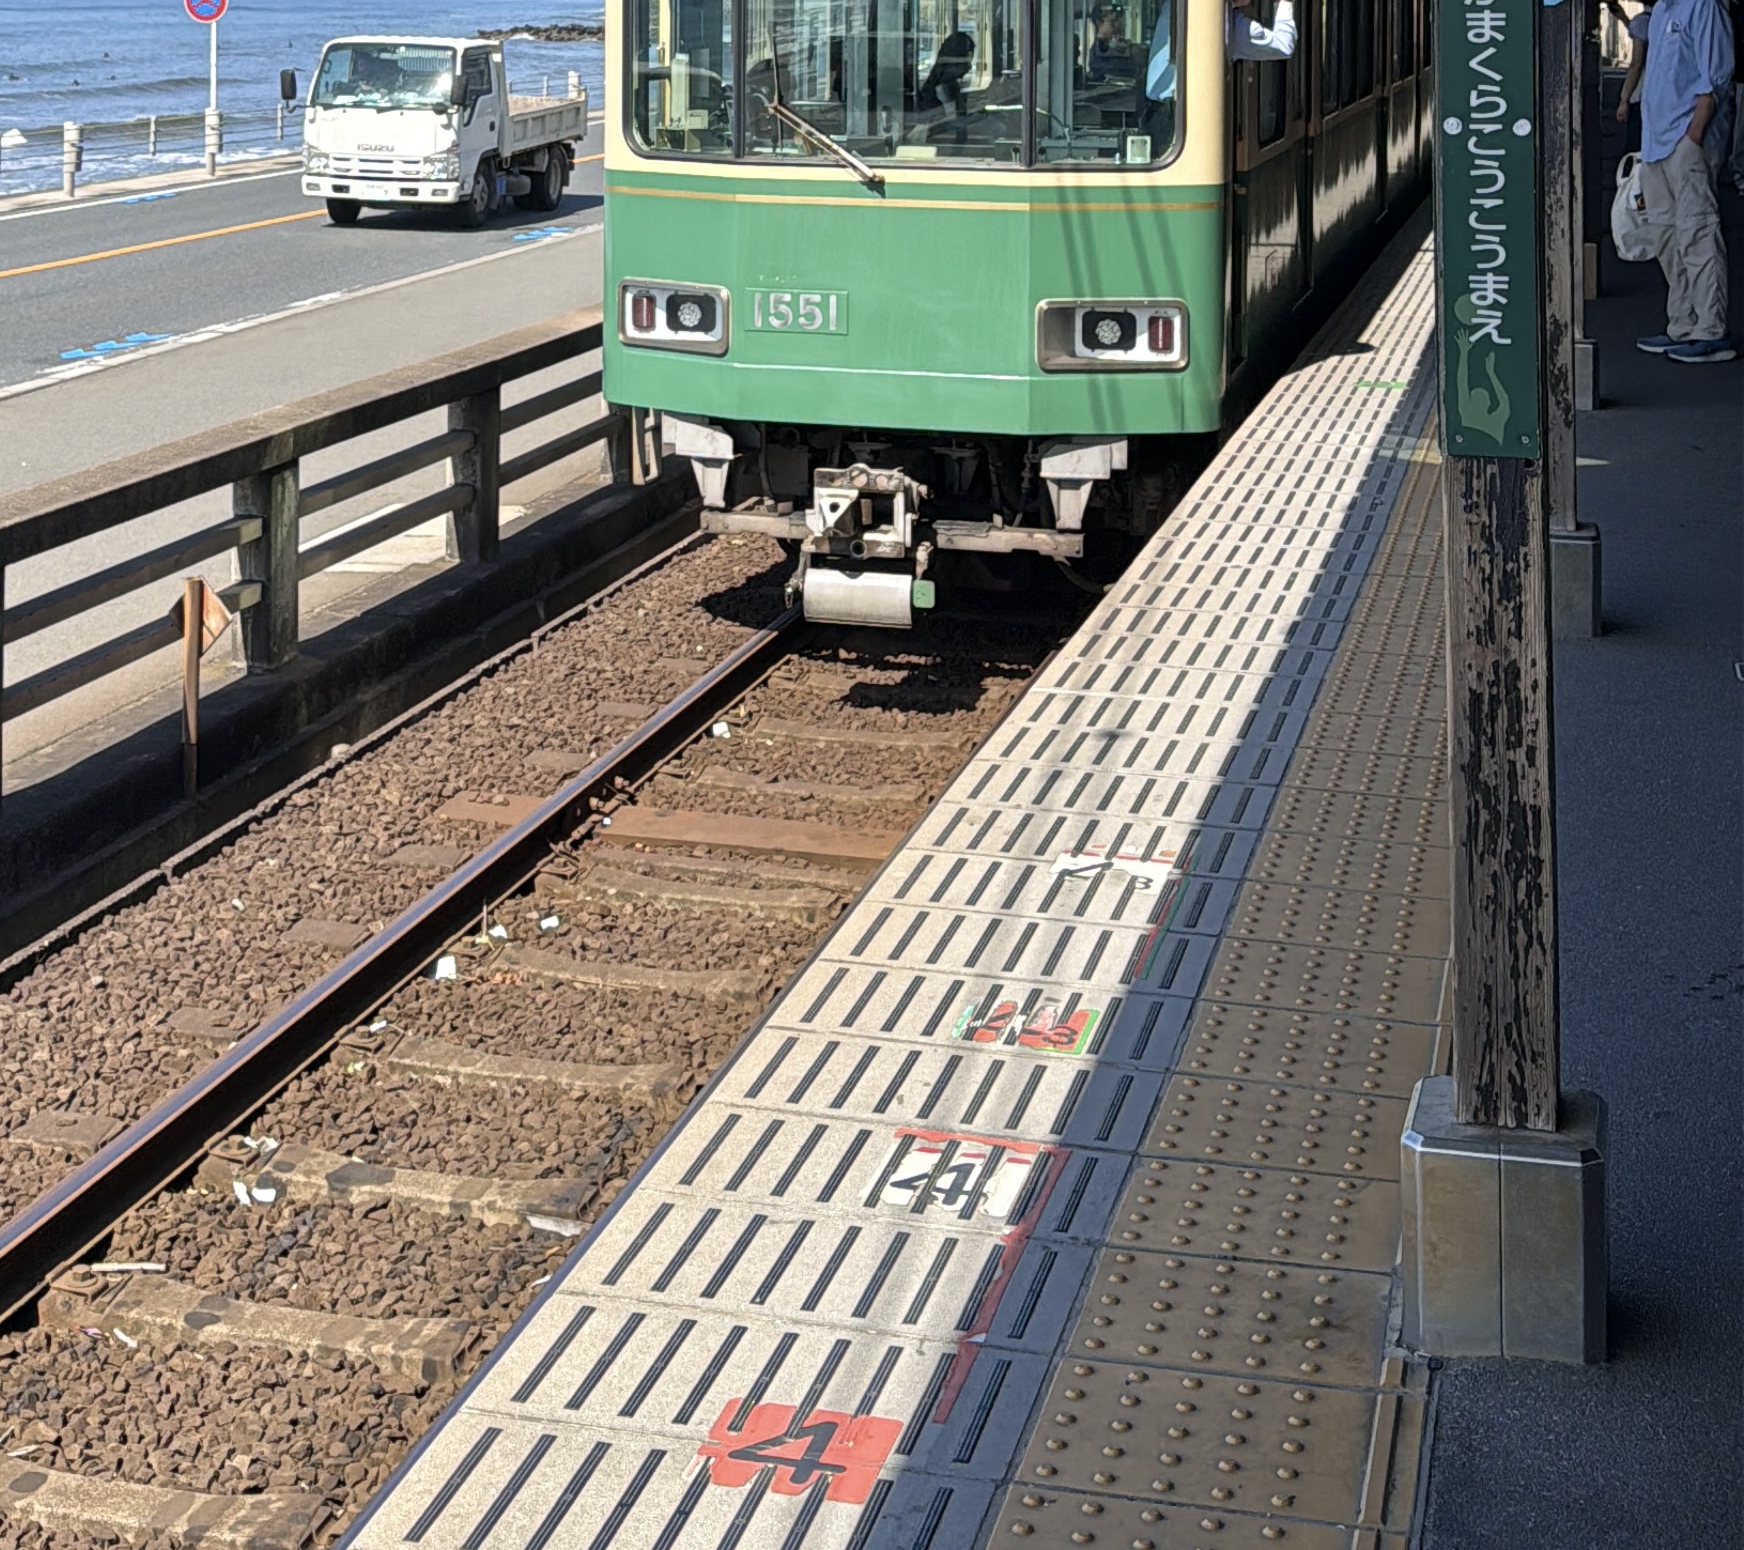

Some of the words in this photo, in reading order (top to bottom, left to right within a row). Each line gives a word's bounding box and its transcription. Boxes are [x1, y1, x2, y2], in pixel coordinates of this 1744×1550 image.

[356, 143, 395, 153] ISUZU
[754, 291, 837, 331] 1551
[889, 1162, 984, 1206] 4
[727, 1420, 848, 1485] 4
